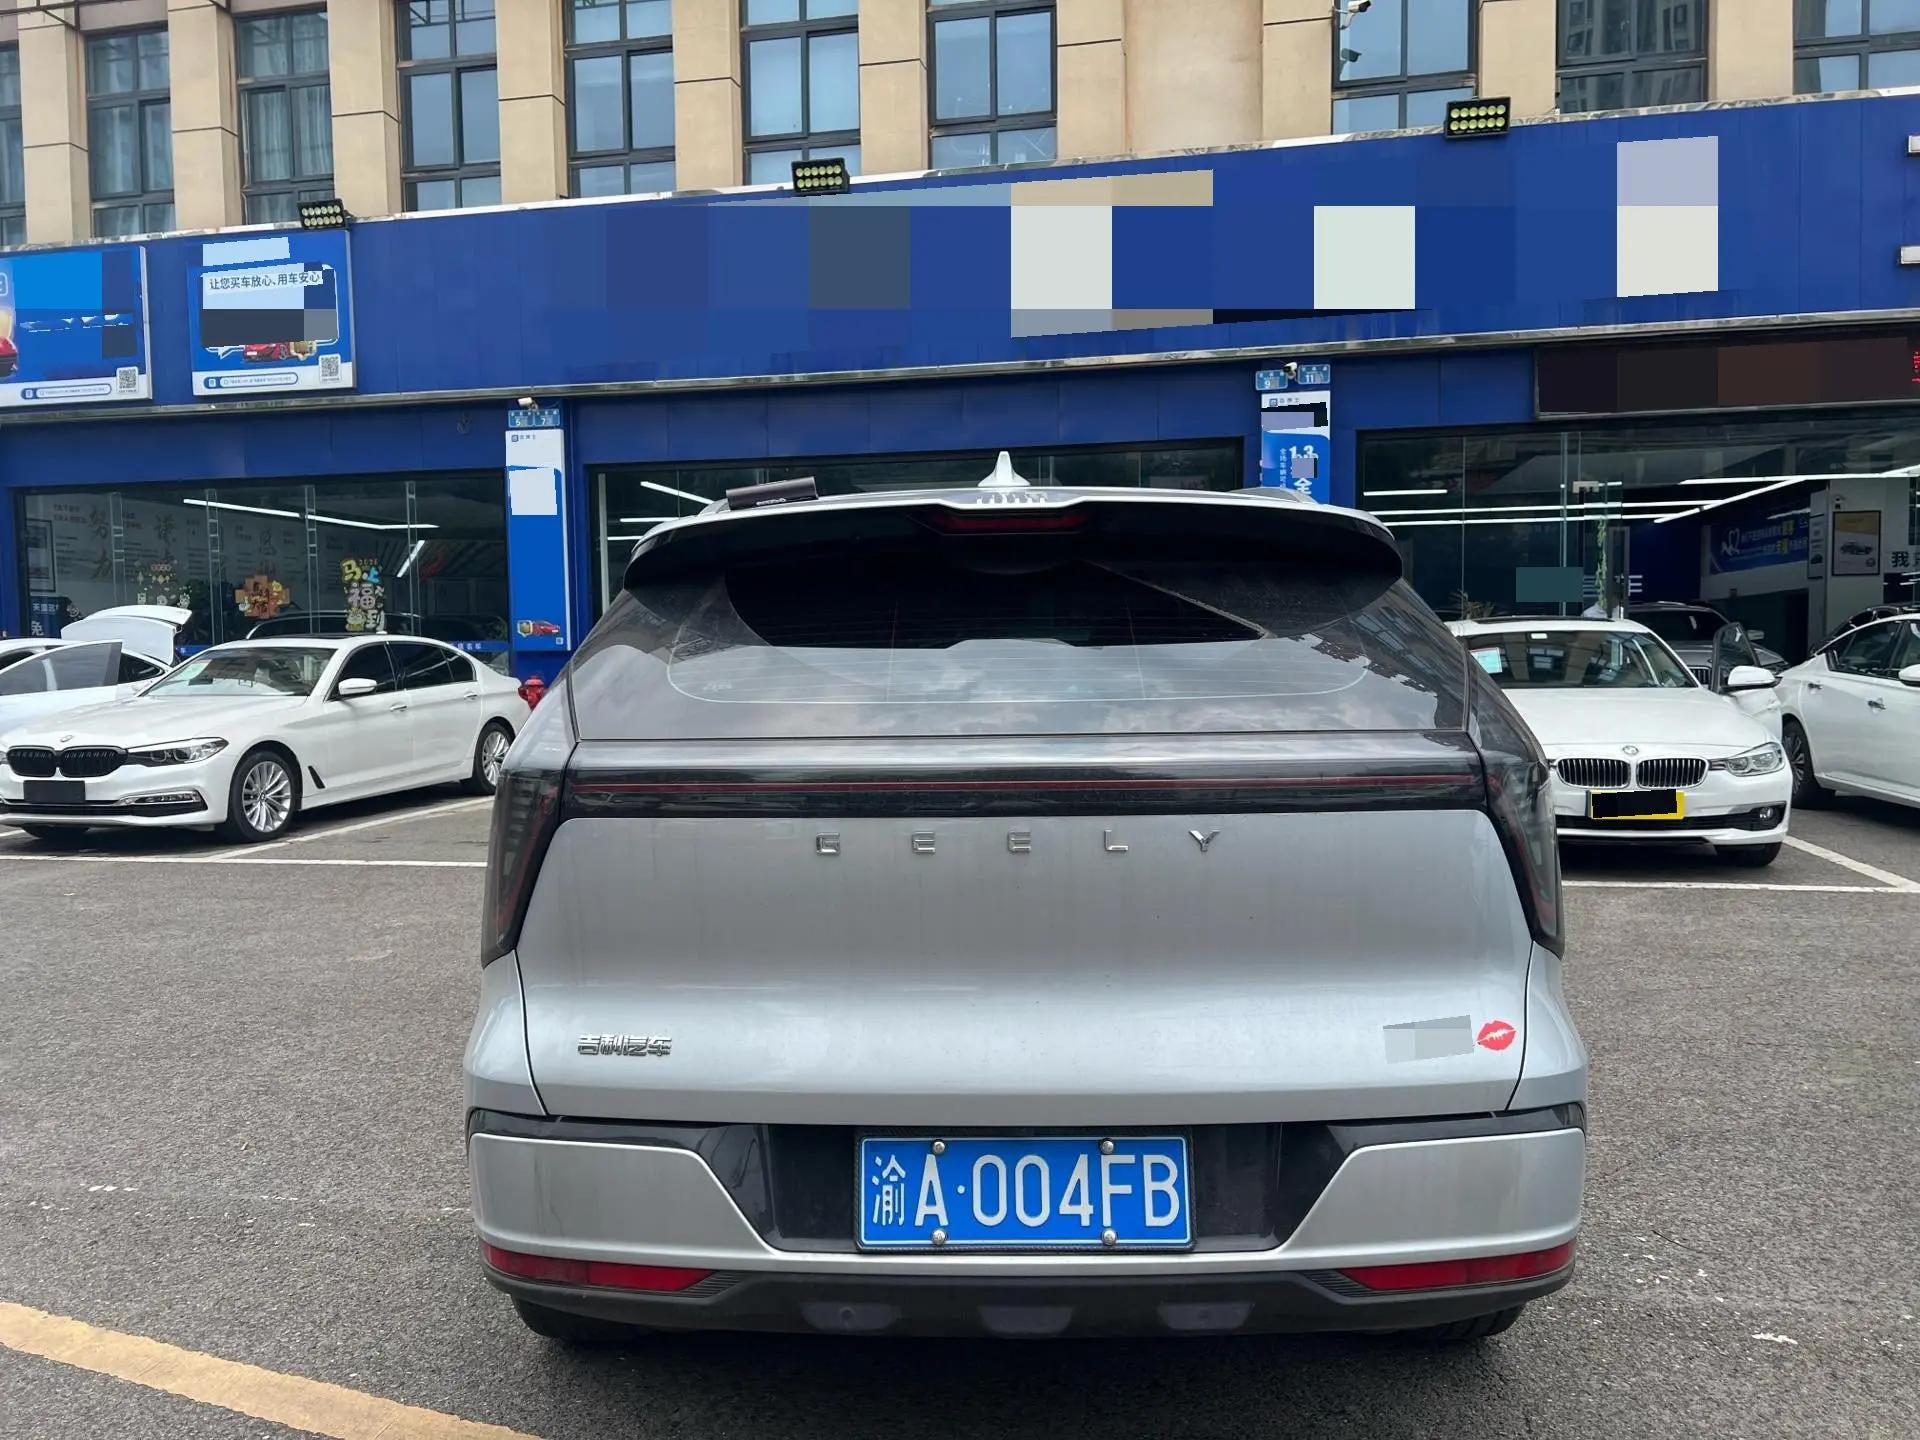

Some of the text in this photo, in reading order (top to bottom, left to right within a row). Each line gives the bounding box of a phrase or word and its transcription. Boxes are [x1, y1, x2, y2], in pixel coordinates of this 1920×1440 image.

[209, 271, 320, 290] 让您买车放心、用车安心
[816, 829, 1220, 855] GEELY
[578, 1032, 672, 1057] 吉利汽车
